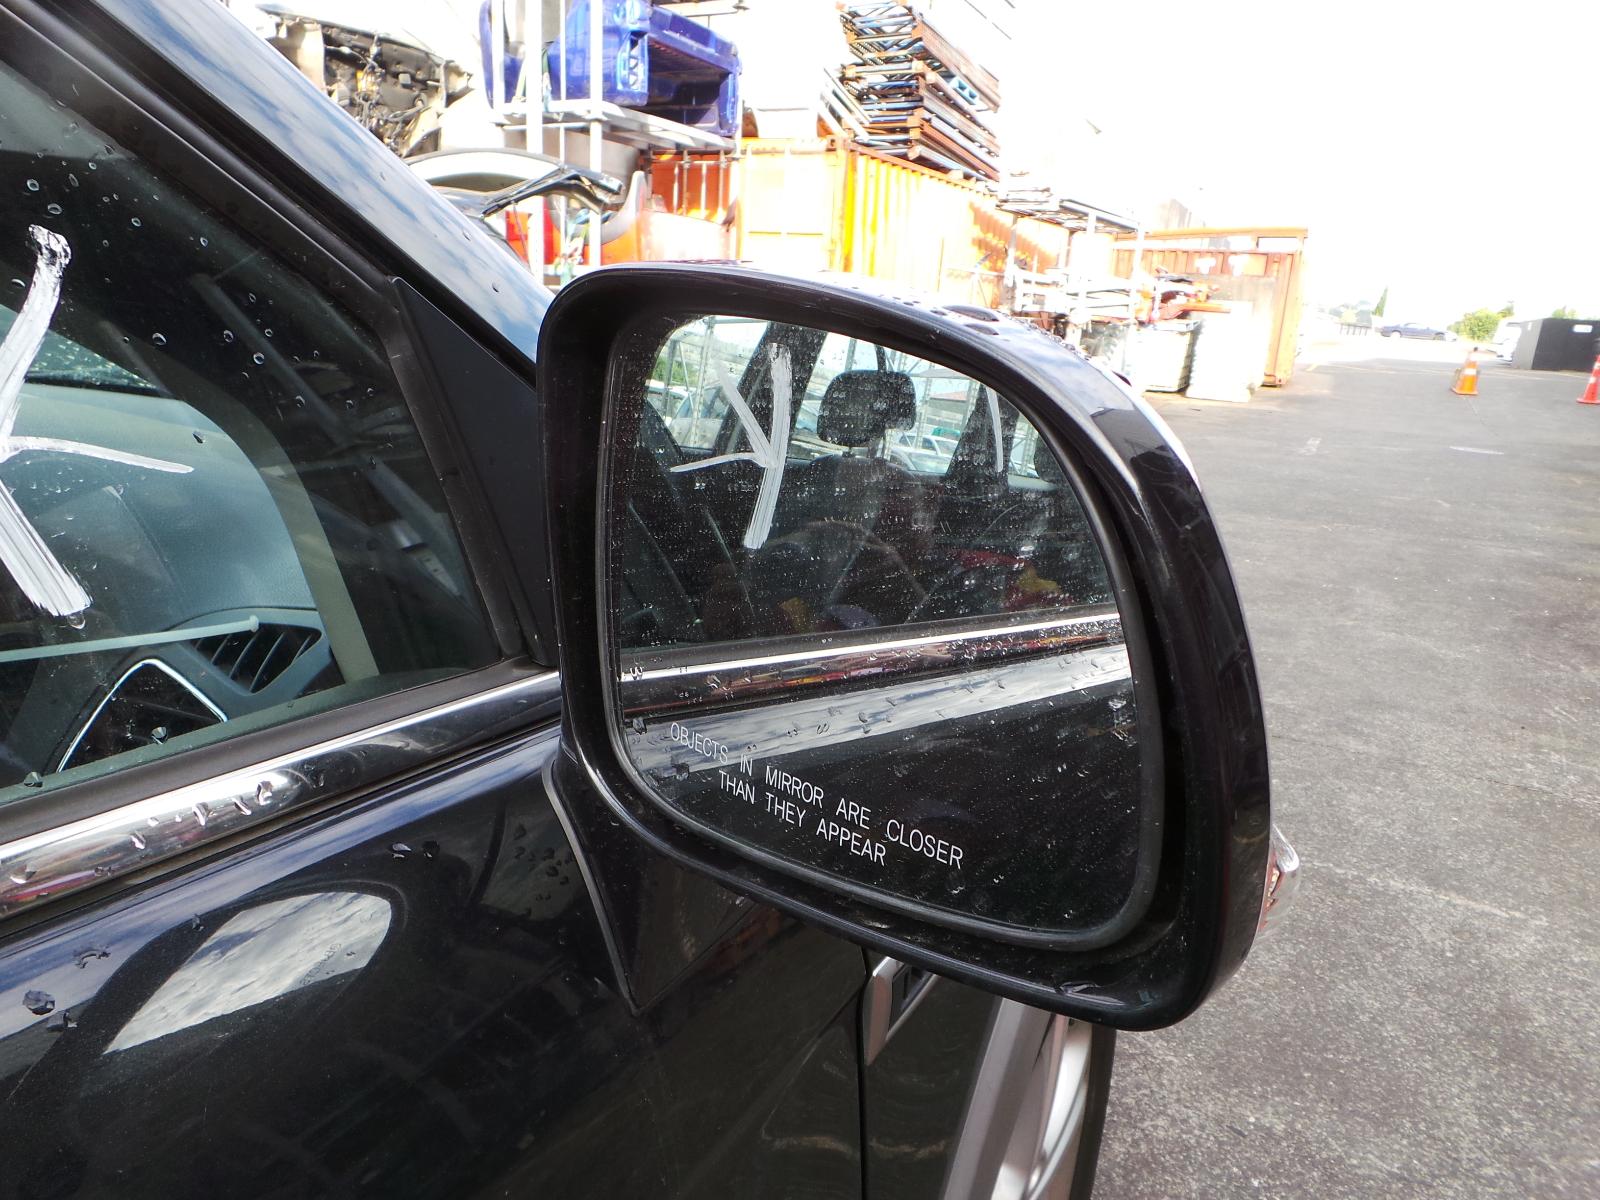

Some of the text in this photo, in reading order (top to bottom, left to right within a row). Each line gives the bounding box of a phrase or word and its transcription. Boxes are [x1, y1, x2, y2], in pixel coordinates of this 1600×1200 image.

[670, 722, 963, 869] OBJECTS IN MIRROR ARE CLOSER
[718, 770, 886, 866] THAN THEY APPEAR
